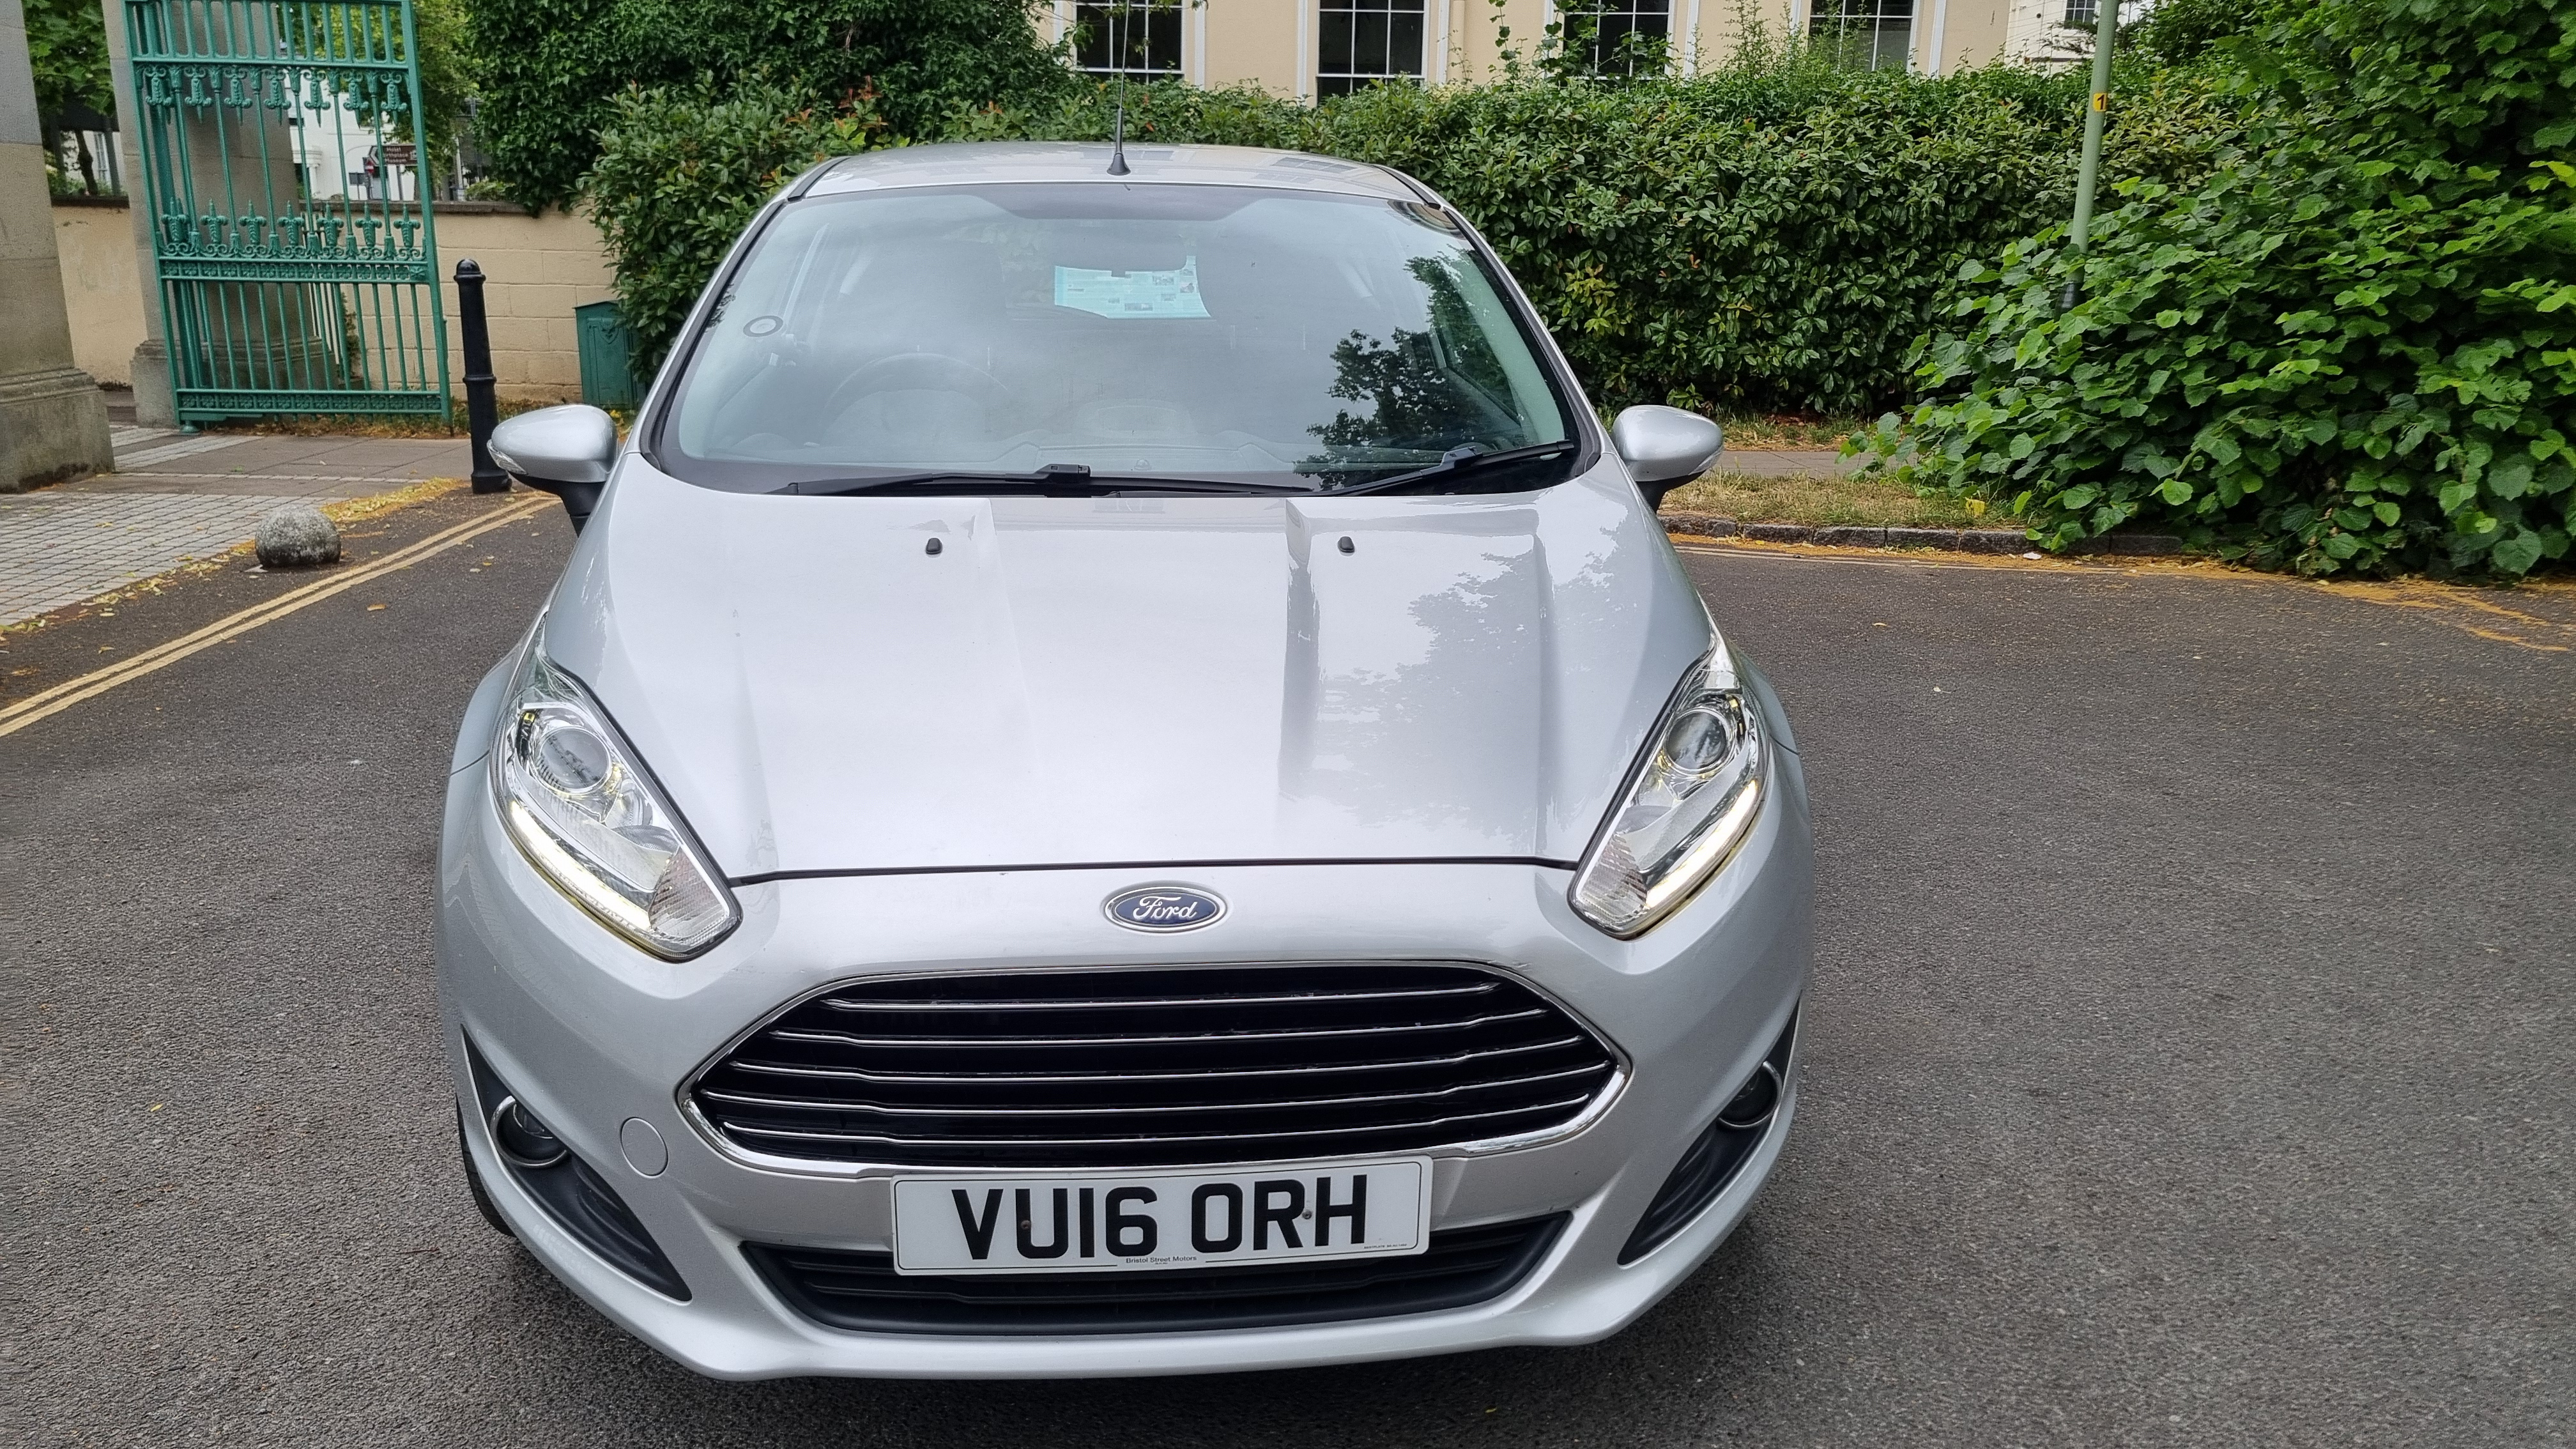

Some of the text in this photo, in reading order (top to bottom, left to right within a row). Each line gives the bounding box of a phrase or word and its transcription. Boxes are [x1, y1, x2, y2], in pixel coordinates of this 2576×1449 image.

[2097, 94, 2104, 110] 1
[1133, 895, 1197, 920] Ford
[951, 1174, 1367, 1260] VU16 ORH
